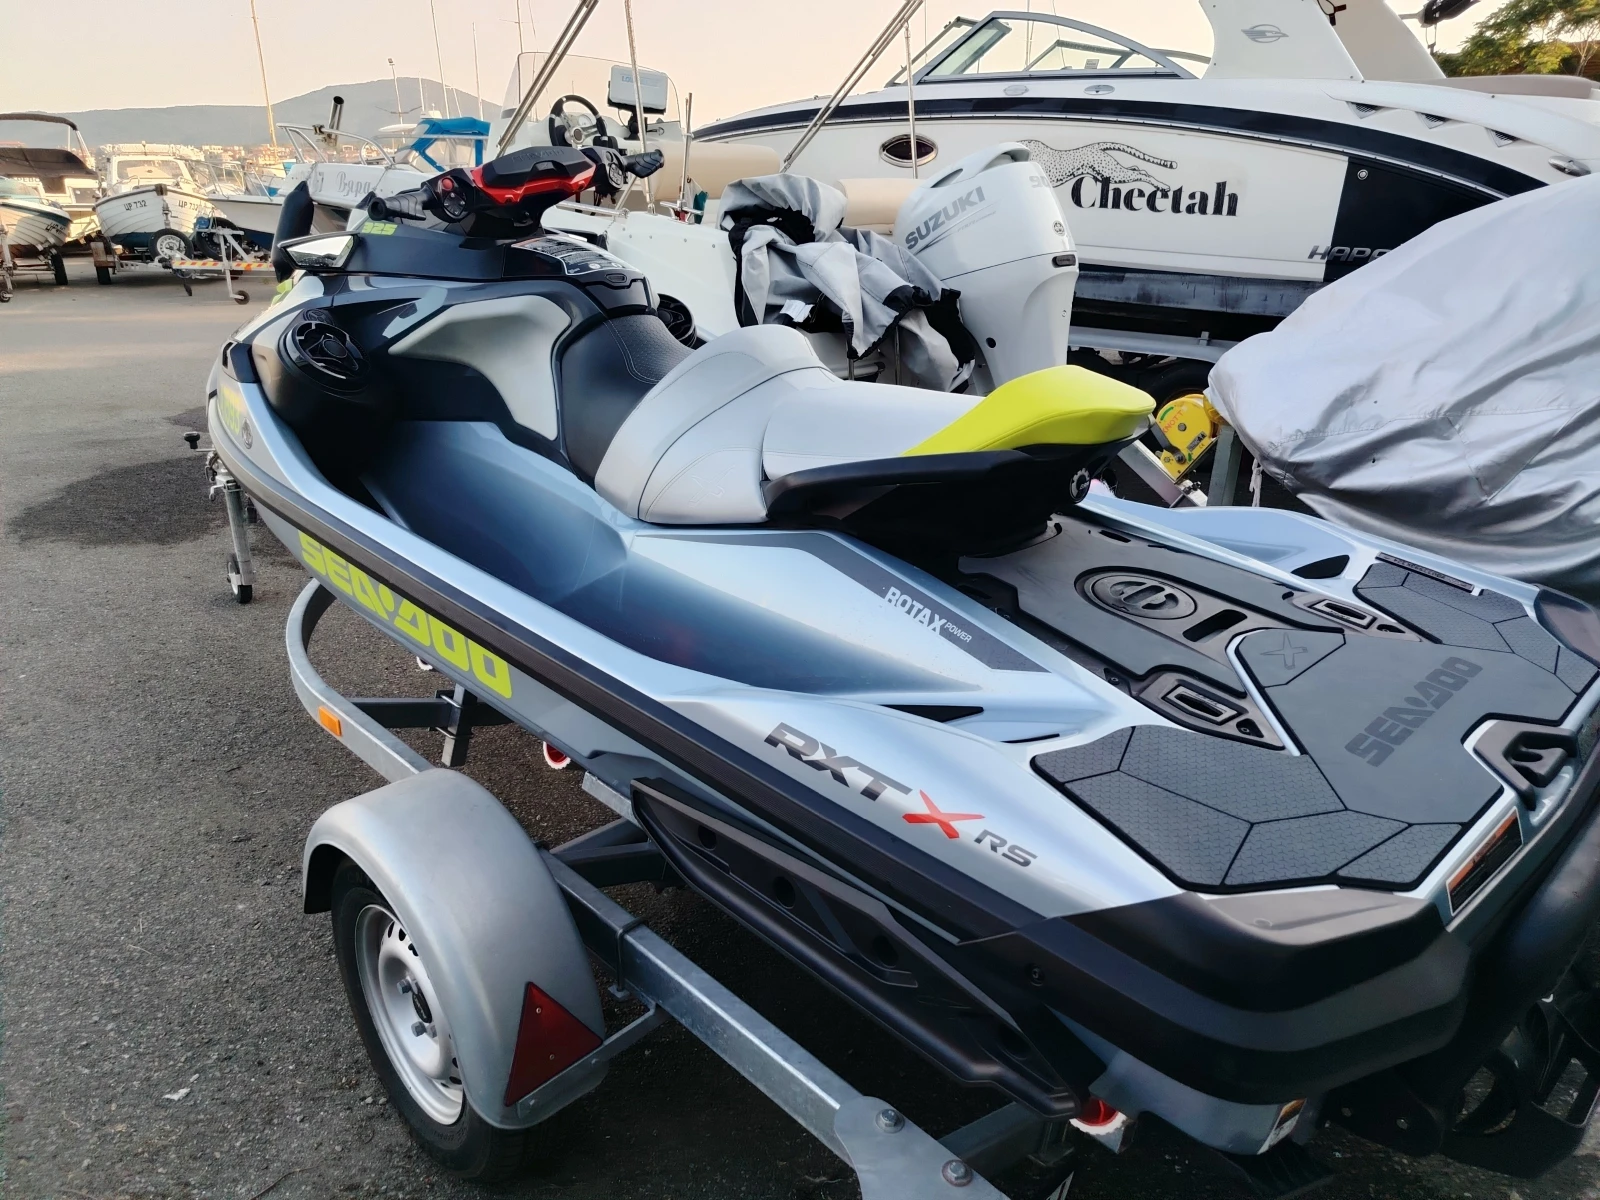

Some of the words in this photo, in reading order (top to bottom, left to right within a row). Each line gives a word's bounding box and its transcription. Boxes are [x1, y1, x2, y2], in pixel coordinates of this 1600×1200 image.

[133, 200, 147, 209] 732
[905, 186, 985, 250] SUZUKI
[1070, 175, 1238, 218] Cheetah
[362, 222, 398, 235] 325
[885, 586, 946, 635] ROTAX
[945, 622, 972, 643] POWER
[902, 789, 985, 839] X
[973, 829, 1039, 868] RS
